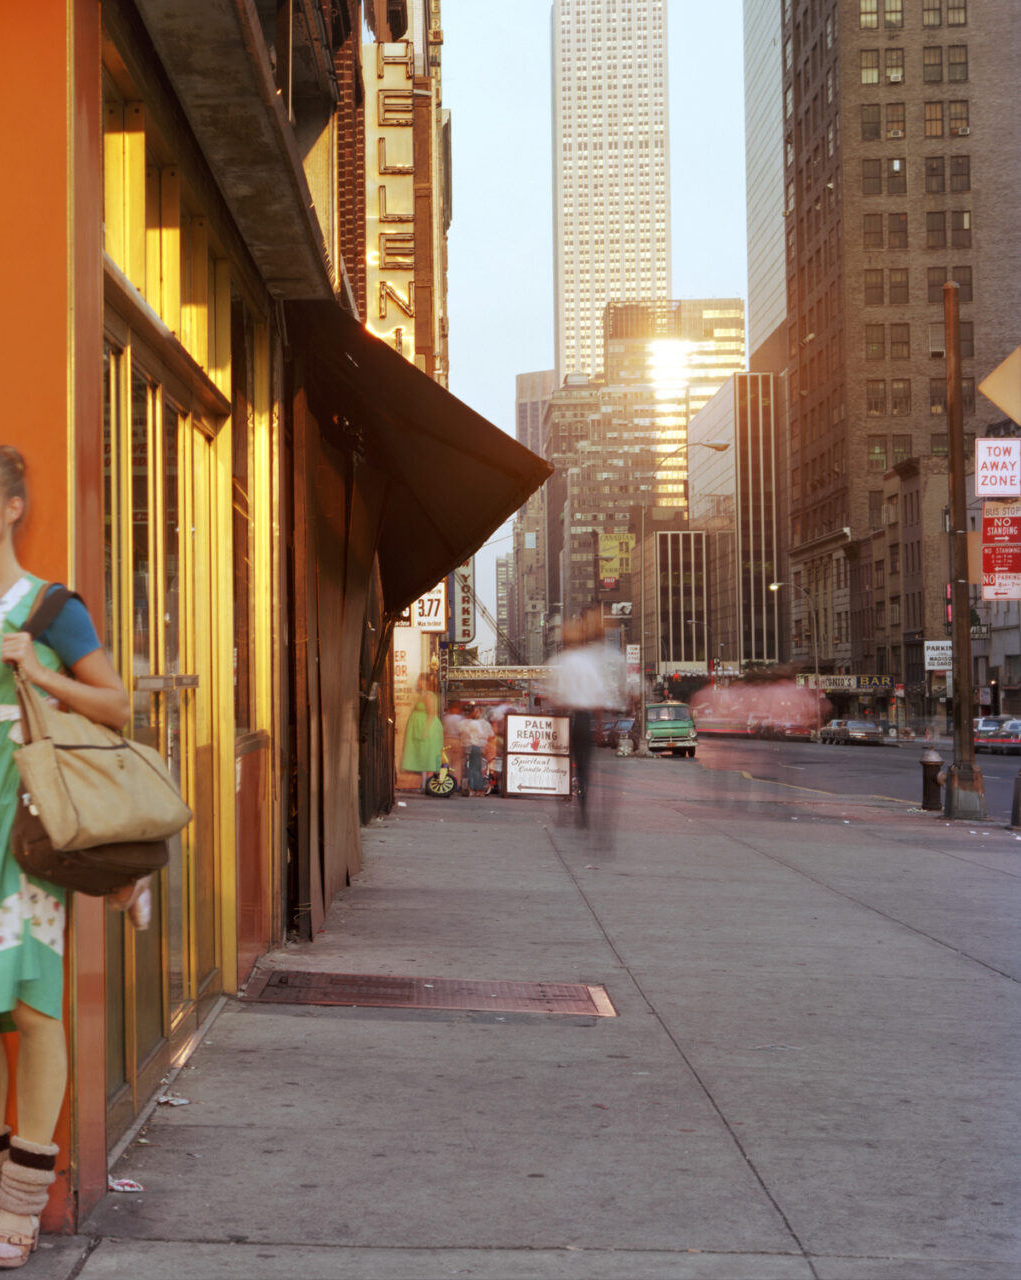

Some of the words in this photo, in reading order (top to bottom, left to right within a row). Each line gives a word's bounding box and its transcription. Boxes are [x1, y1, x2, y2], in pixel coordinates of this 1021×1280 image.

[378, 41, 416, 357] HELLENI
[986, 446, 1012, 457] TOW
[980, 461, 1017, 472] AWAY
[980, 476, 1018, 486] ZONE
[986, 506, 1000, 517] BUS
[994, 518, 1011, 526] NO
[987, 527, 1018, 536] STANDING
[984, 575, 995, 585] NO
[418, 598, 440, 617] 3.77
[461, 574, 470, 638] YORKER
[860, 677, 890, 686] BAR
[525, 720, 552, 729] PALM
[516, 730, 558, 740] READING
[511, 757, 550, 767] Spiritual
